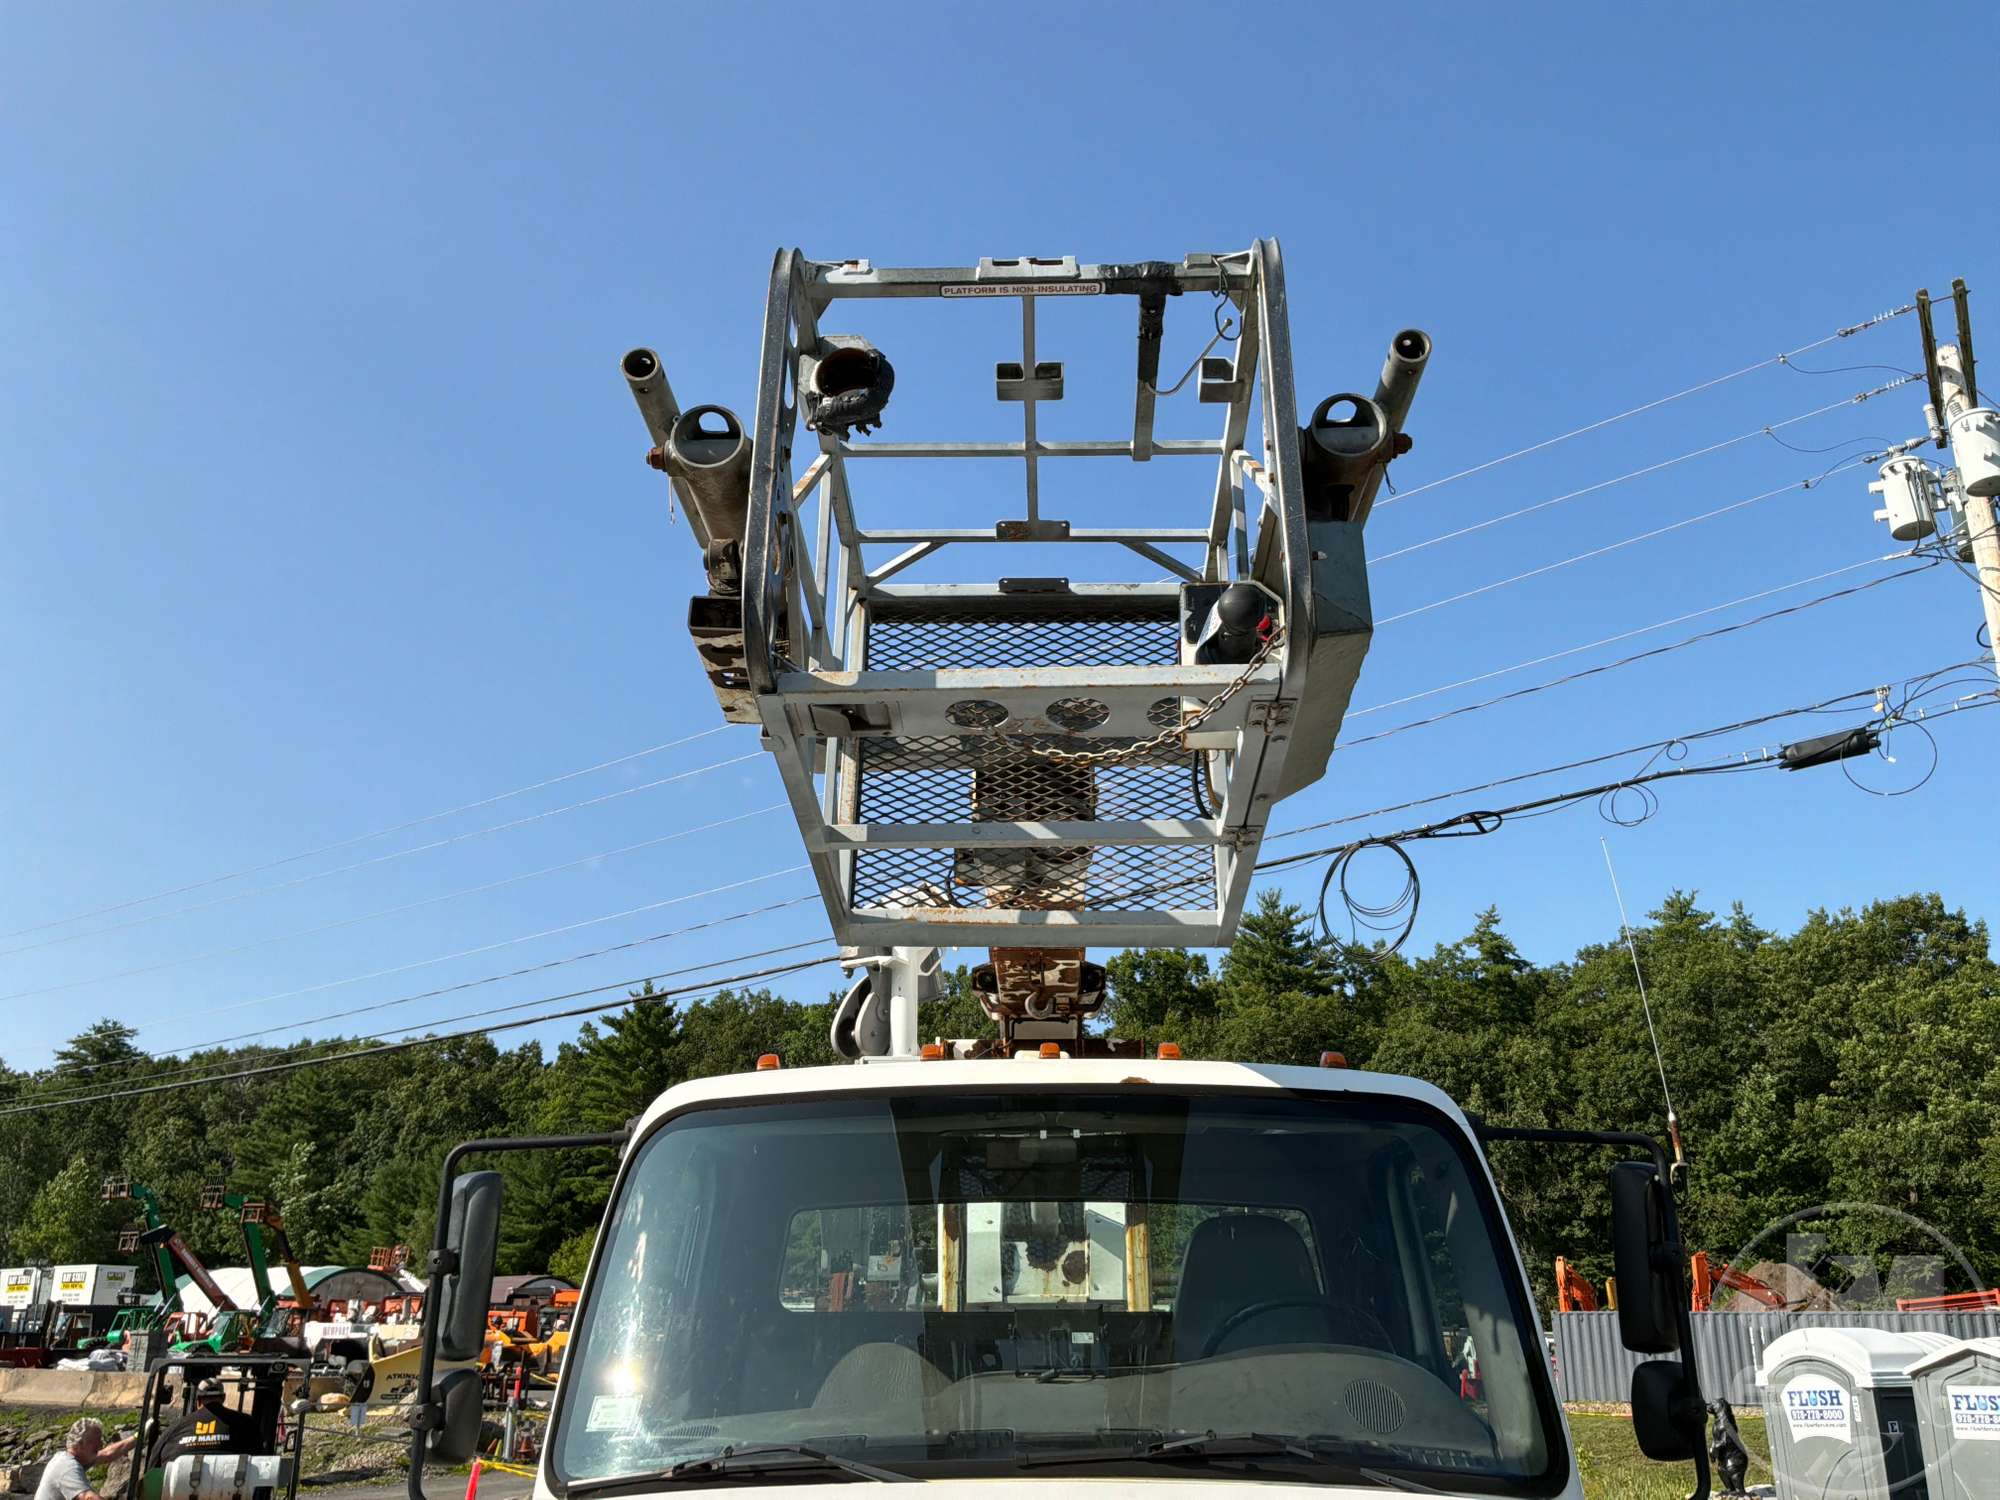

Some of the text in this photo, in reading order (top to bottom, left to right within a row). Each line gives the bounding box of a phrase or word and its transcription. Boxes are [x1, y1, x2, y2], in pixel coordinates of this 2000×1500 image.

[943, 285, 1097, 295] PLATFORM IS NON-INSULATING
[1787, 1390, 1843, 1407] FLUSH
[178, 1434, 230, 1445] JEFF MARTIN
